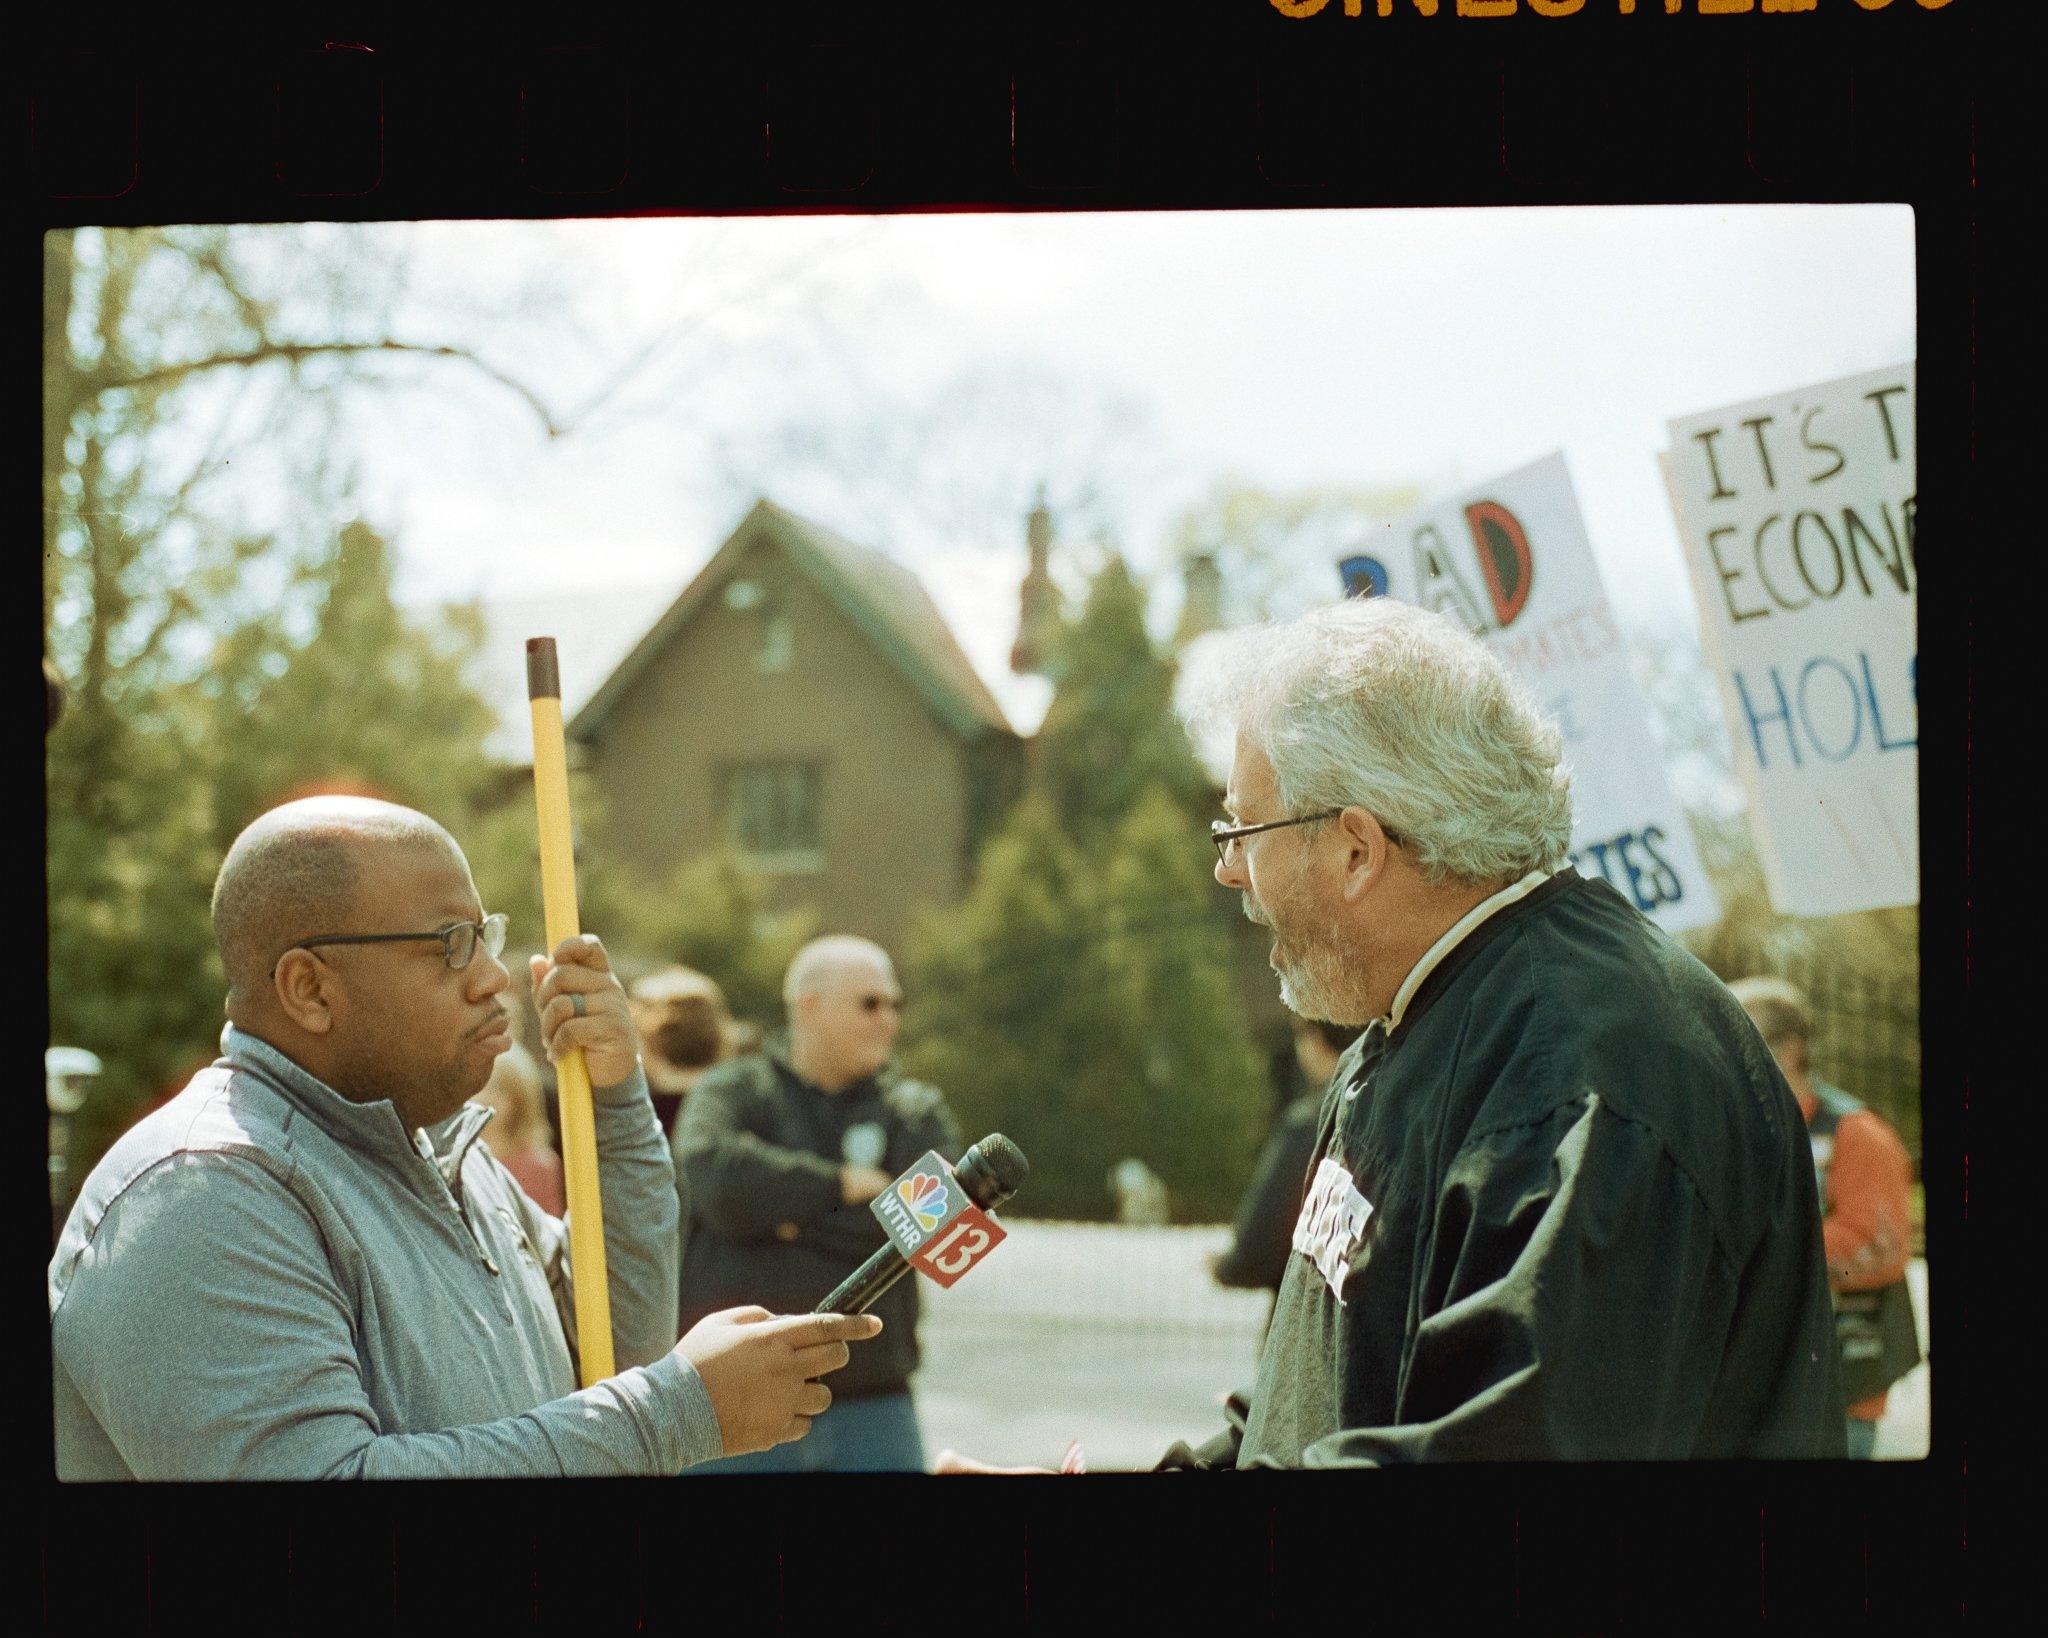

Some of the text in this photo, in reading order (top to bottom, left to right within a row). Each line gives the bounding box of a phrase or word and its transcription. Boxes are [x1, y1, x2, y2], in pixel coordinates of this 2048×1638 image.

[1691, 401, 1846, 500] IT'S
[1733, 651, 1919, 768] HOL
[1567, 824, 1684, 912] TES
[879, 1191, 922, 1250] WTHR
[923, 1222, 990, 1275] 13
